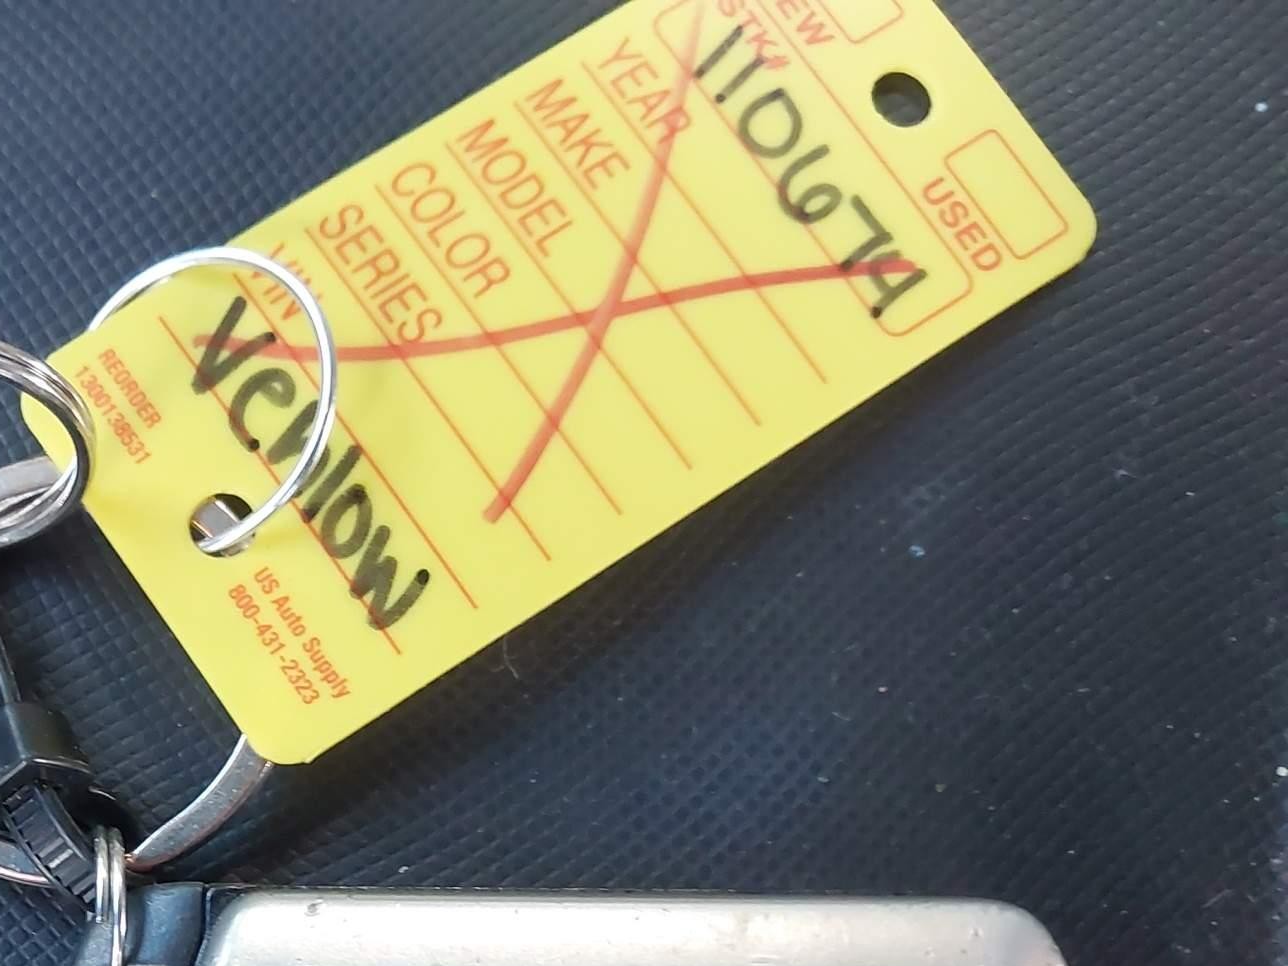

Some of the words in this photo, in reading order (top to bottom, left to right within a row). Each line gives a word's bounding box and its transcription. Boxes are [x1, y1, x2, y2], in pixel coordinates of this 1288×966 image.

[776, 0, 836, 45] EW
[524, 78, 631, 190] MAKE
[598, 36, 692, 145] YEAR
[391, 162, 511, 299] COLOR
[455, 117, 574, 259] MODEL
[922, 177, 1003, 272] USED
[319, 204, 443, 344] SERIES
[98, 348, 162, 429] REORDER
[228, 583, 321, 705] 800-431-2323
[253, 566, 280, 595] US
[271, 595, 306, 638] Auto
[302, 637, 352, 699] Supply
